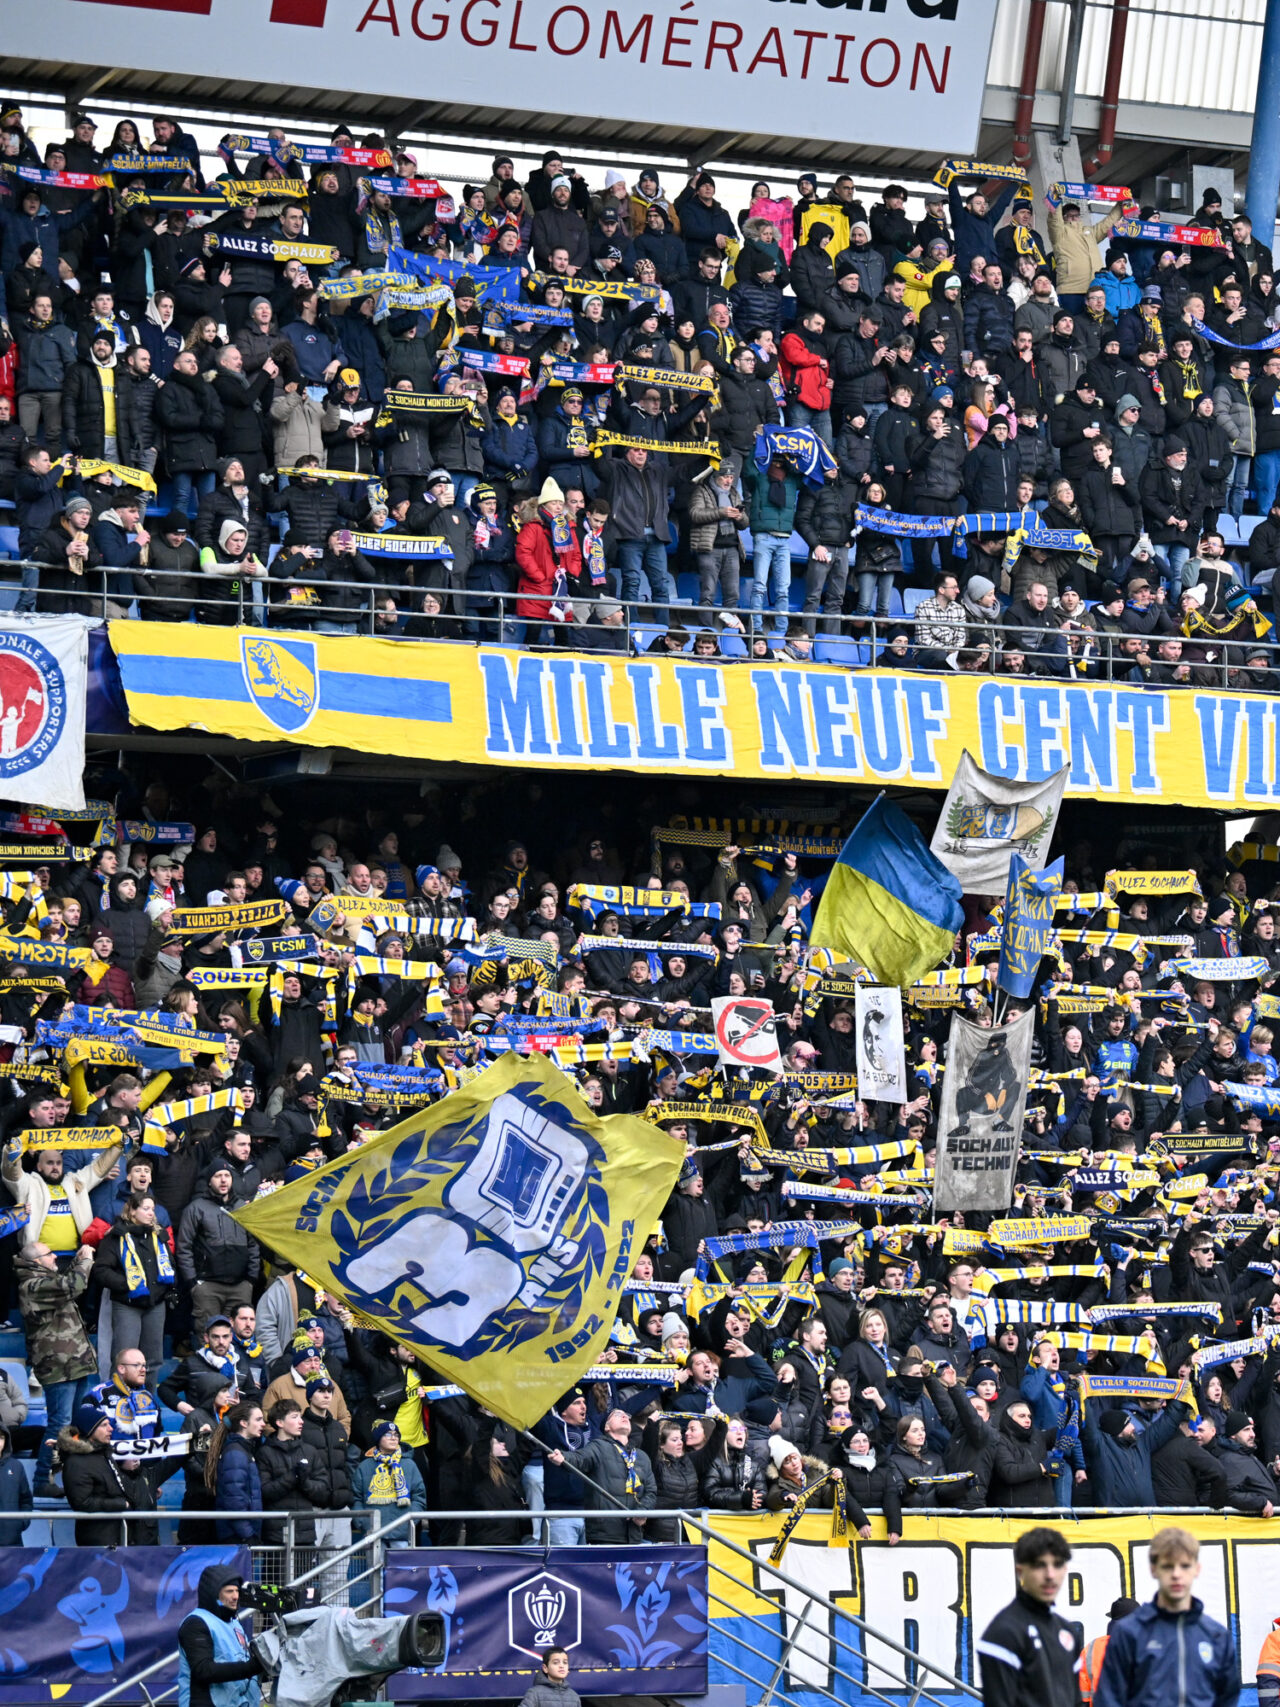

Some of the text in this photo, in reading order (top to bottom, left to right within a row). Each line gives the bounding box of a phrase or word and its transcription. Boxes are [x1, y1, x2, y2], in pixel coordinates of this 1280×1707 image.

[356, 0, 952, 94] AGGLOMÉRATION
[223, 236, 326, 259] ALLEZ SOCHAUX
[354, 536, 435, 554] LLEZ SOCHAUX
[33, 668, 63, 760] SUPPORTERS
[478, 652, 732, 772] MILLE
[750, 667, 953, 782] NEUF
[978, 681, 1169, 798] CENT
[1150, 876, 1190, 889] SOCHAUX
[273, 940, 307, 953] FCSM
[821, 980, 829, 989] FC
[681, 1032, 718, 1050] FCS
[665, 1102, 707, 1114] SOCHAUX
[27, 1125, 115, 1144] ALLEZ SOCHAUX
[946, 1134, 1016, 1153] SOCHAUX
[1167, 1134, 1244, 1148] FC SOCHAUX MONTBÉLIARD
[951, 1155, 1011, 1172] TECHNO
[1074, 1170, 1111, 1185] ALLEZ
[543, 1312, 606, 1364] 1992
[1091, 1378, 1175, 1391] ULTRAS SOCHALIENS
